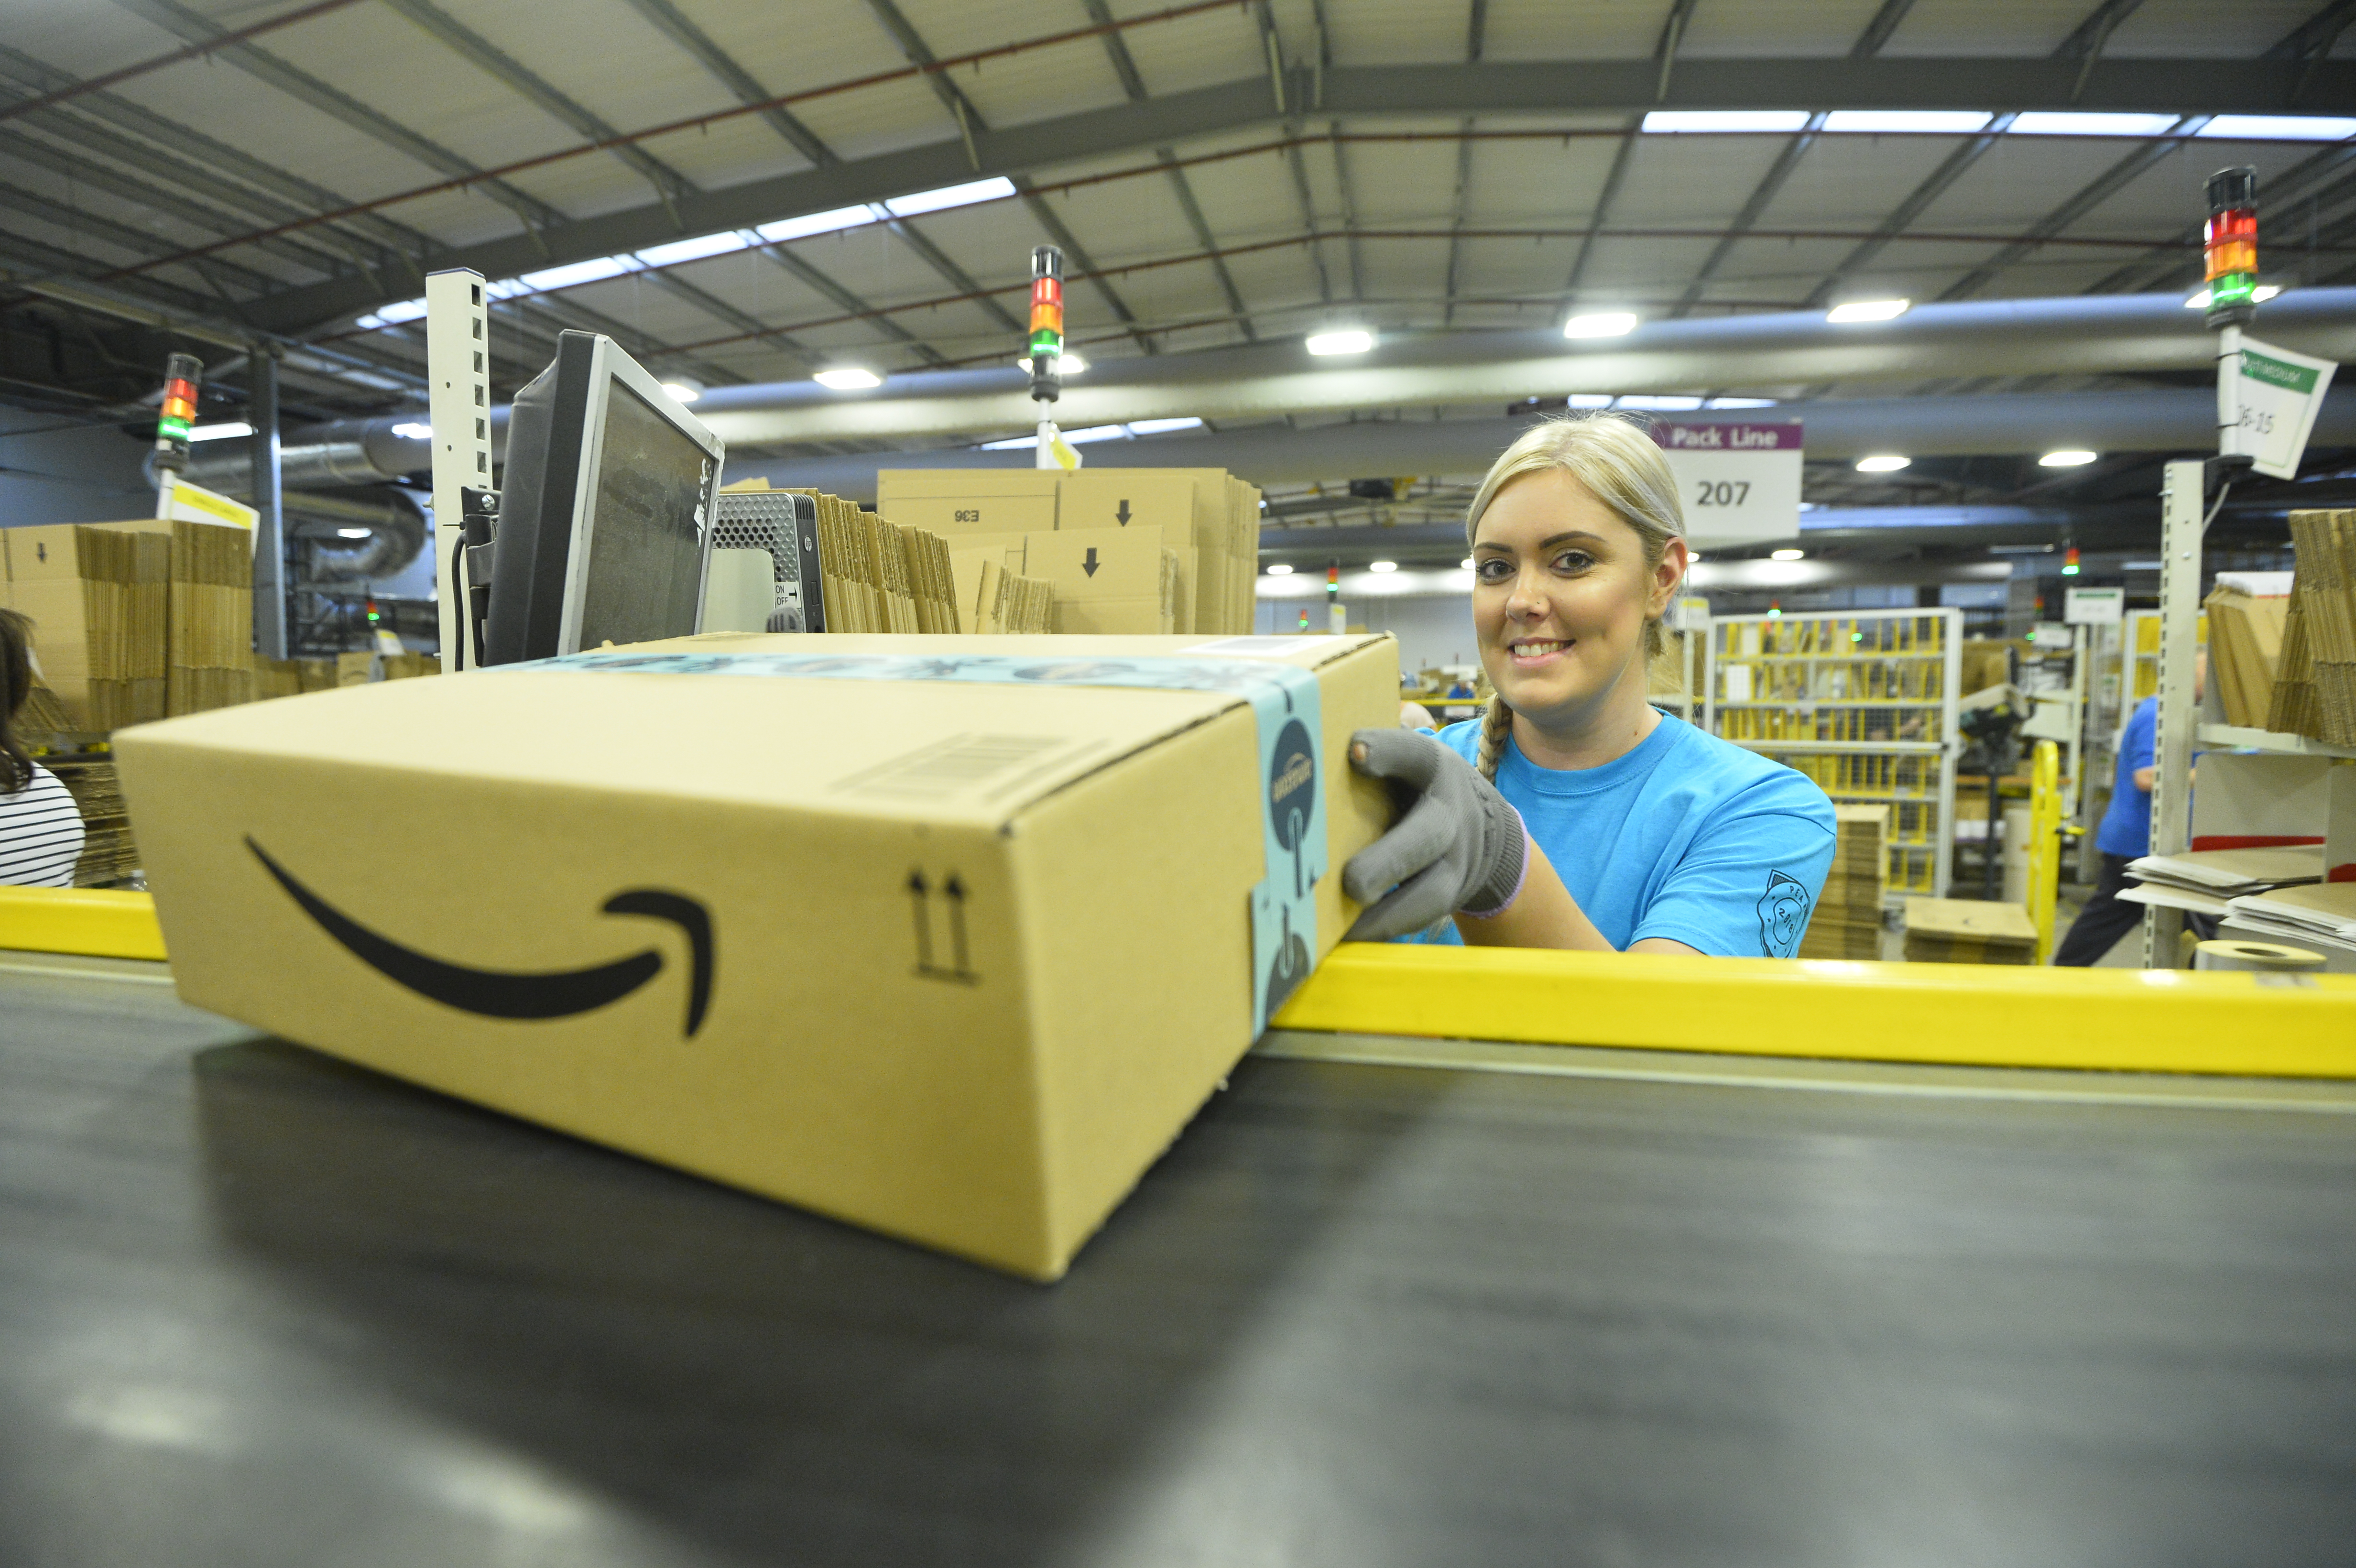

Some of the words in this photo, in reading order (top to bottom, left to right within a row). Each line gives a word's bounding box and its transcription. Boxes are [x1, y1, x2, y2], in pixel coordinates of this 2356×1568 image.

[1671, 427, 1722, 446] Pack
[1731, 427, 1778, 447] Line
[1697, 481, 1751, 507] 207
[955, 510, 980, 522] E36
[775, 585, 785, 594] ON
[776, 597, 788, 605] OFF
